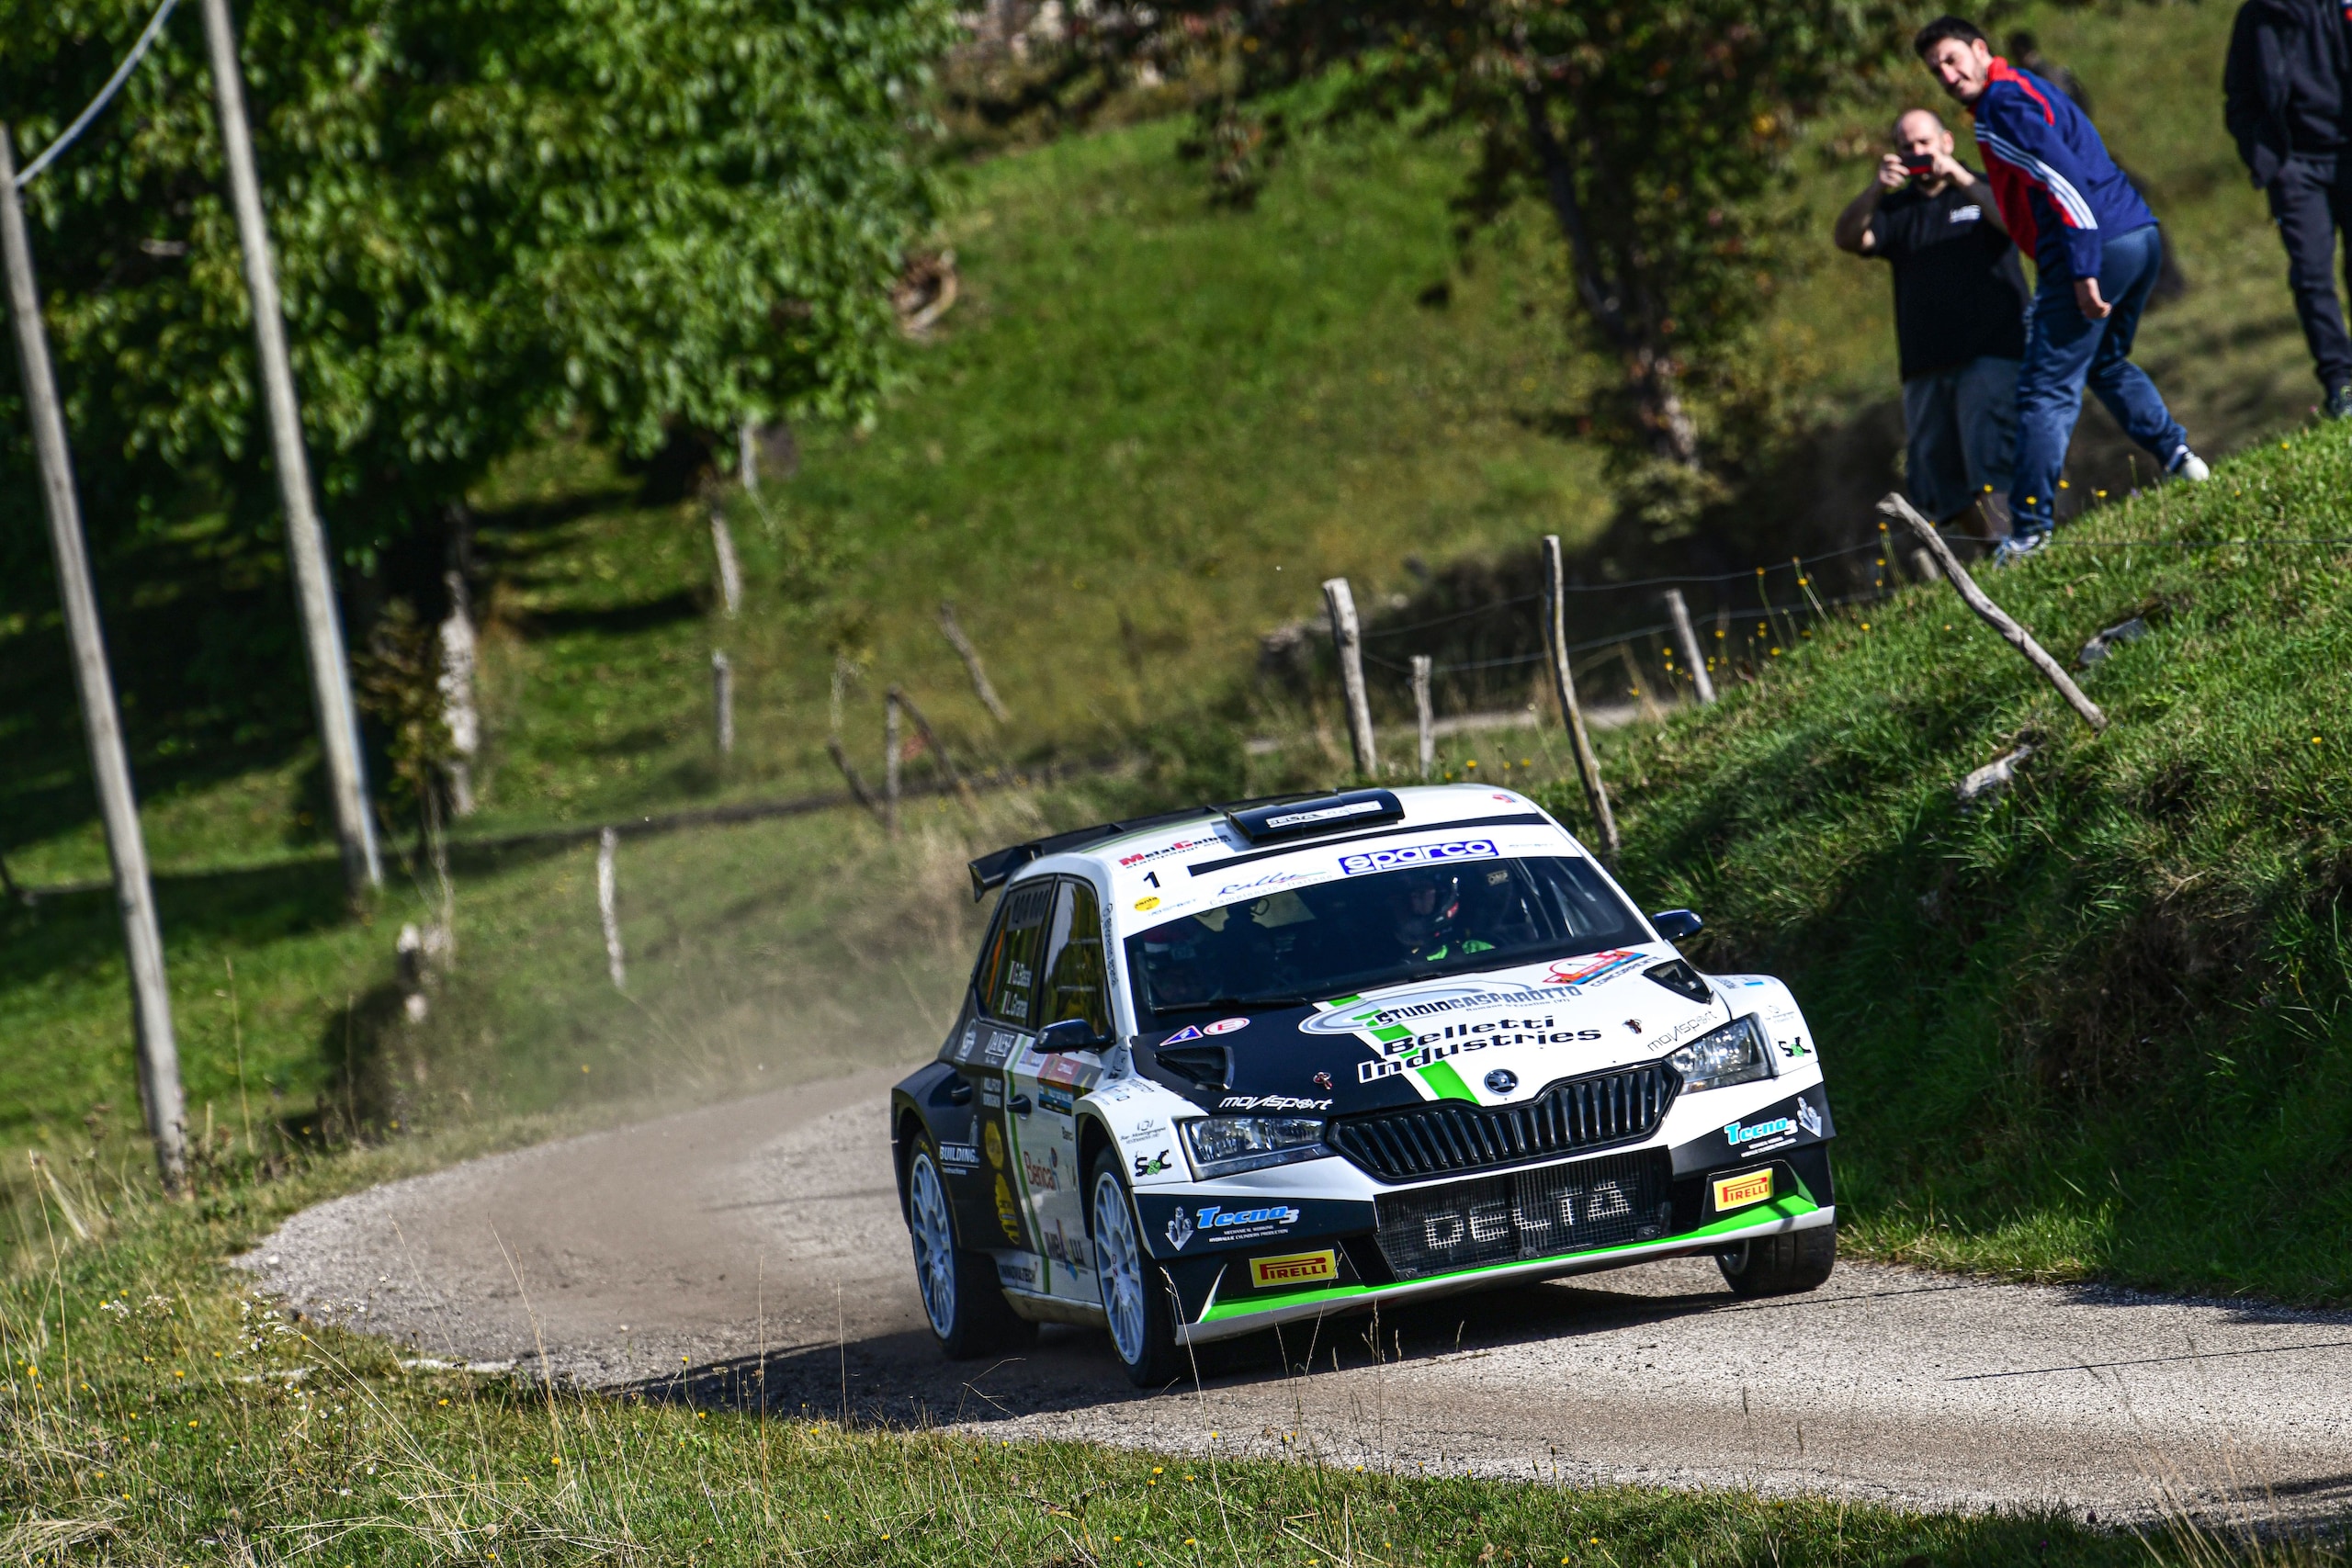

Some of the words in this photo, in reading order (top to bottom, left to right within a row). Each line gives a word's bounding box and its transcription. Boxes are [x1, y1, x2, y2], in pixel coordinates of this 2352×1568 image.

[1343, 840, 1496, 874] sparco
[1143, 871, 1160, 889] 1
[1384, 1015, 1555, 1056] Belletti
[1647, 1010, 1718, 1052] movisport
[1361, 1029, 1602, 1081] Industries
[1218, 1095, 1334, 1111] movisport
[940, 1145, 976, 1164] BUILDING
[1722, 1177, 1769, 1203] PIRELLI
[1424, 1180, 1632, 1249] DELTA
[1260, 1257, 1327, 1280] PIRELLI
